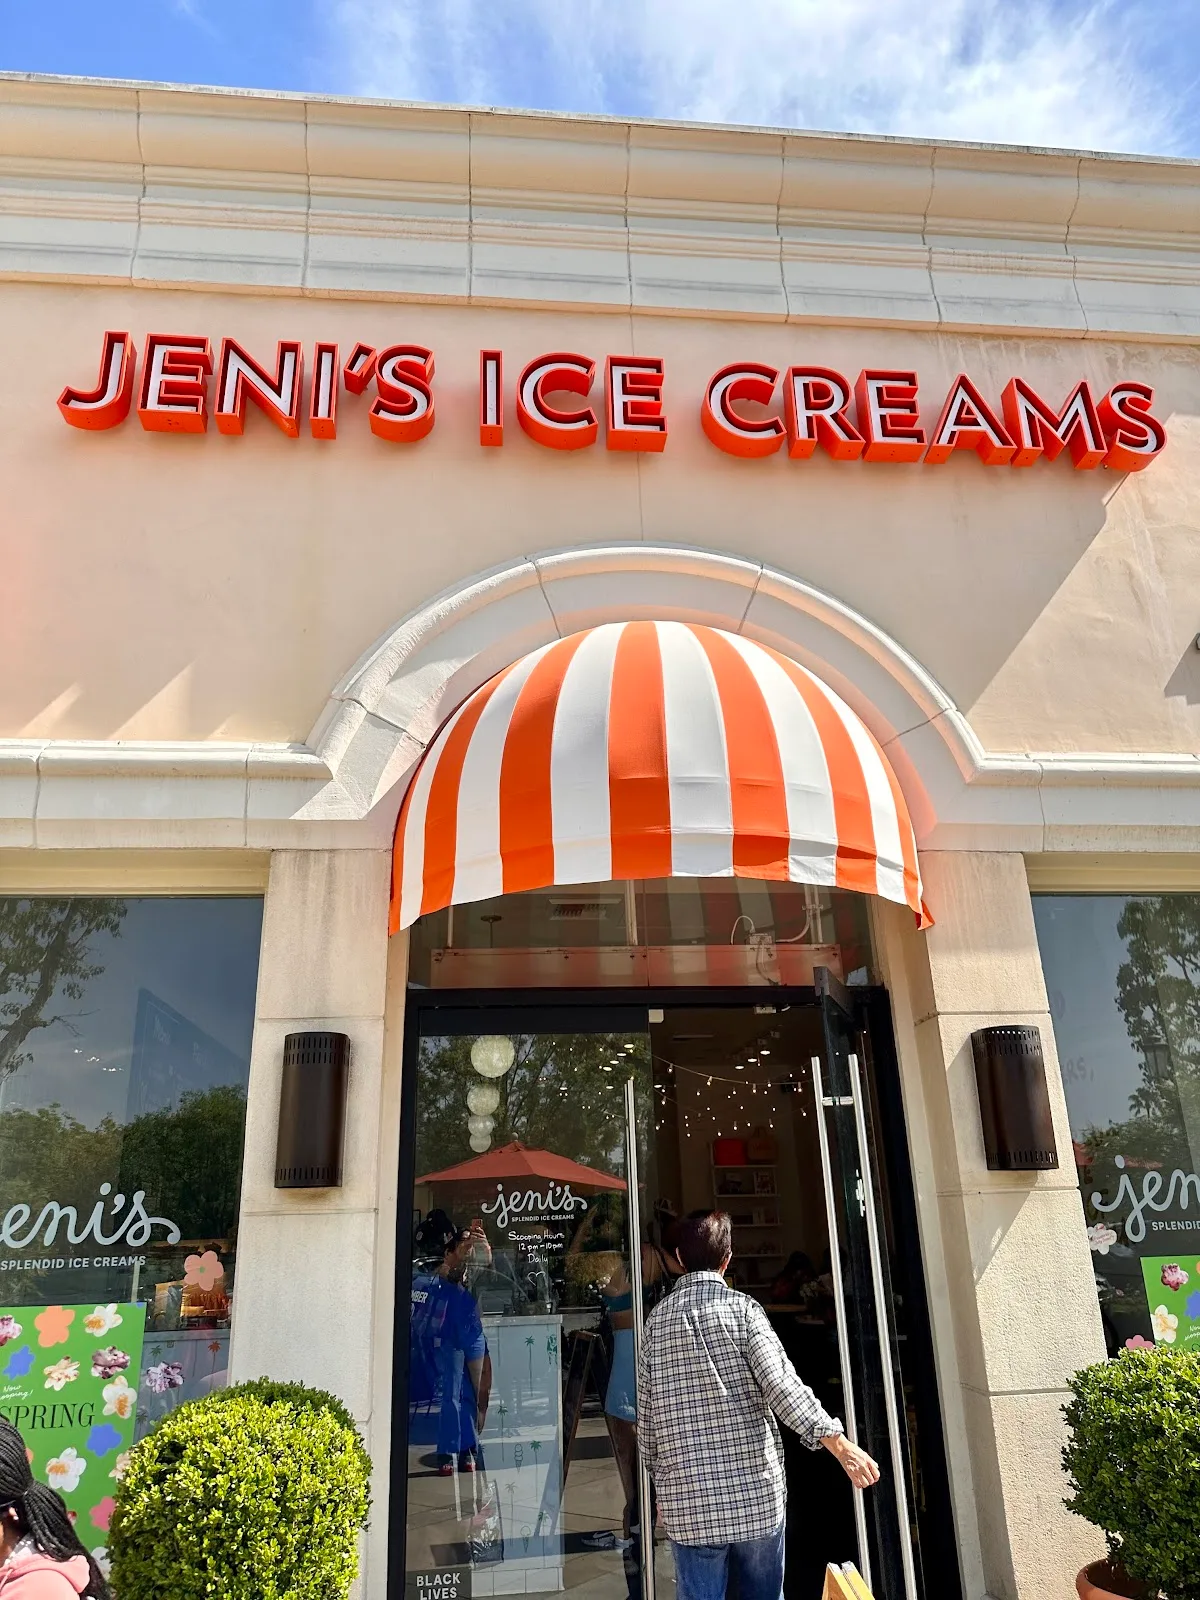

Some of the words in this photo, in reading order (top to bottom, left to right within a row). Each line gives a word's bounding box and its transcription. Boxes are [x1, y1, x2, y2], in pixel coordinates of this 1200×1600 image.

[57, 331, 435, 442] JENI'S
[480, 350, 668, 452] ICE
[701, 362, 1167, 472] CREAMS
[481, 1180, 588, 1228] jeni's
[0, 1182, 181, 1249] eni's
[508, 1230, 543, 1243] Scooping
[543, 1228, 565, 1240] Hours
[0, 1258, 65, 1271] SPLENDID
[69, 1257, 90, 1268] ICE
[93, 1256, 147, 1267] CREAMS
[527, 1253, 548, 1264] Daily
[416, 1572, 461, 1587] BLACK
[420, 1587, 458, 1600] LIVES
